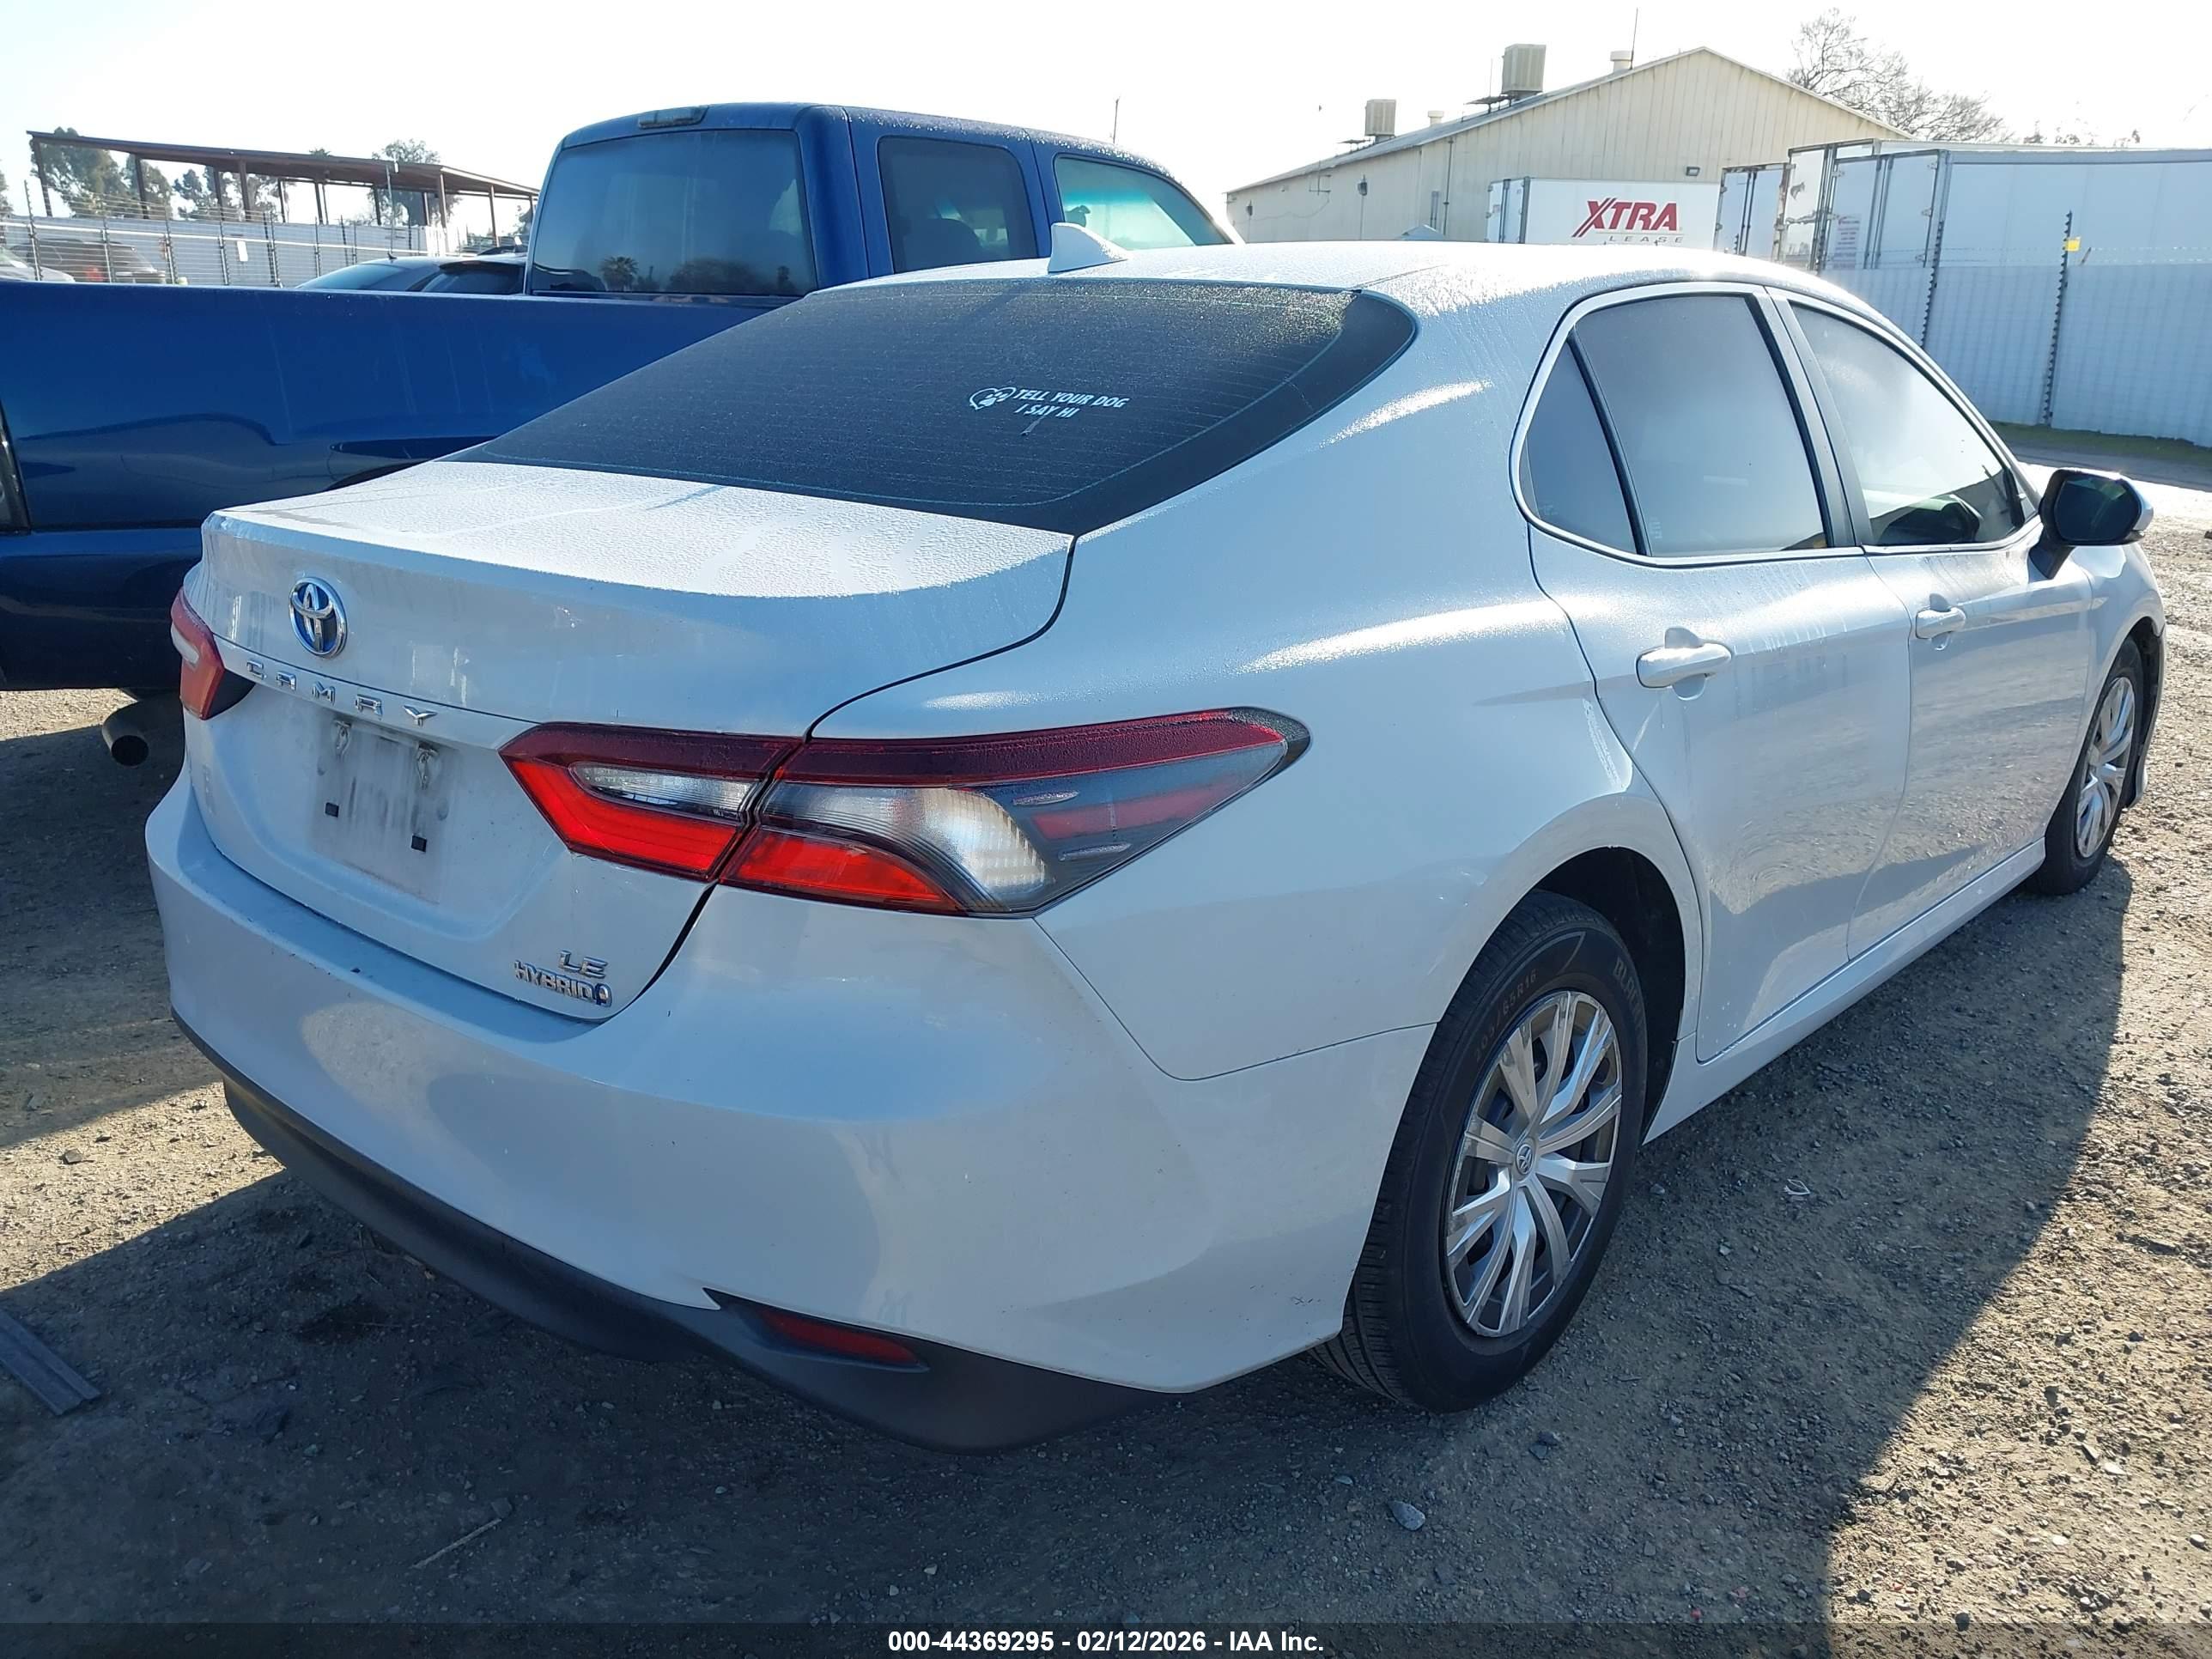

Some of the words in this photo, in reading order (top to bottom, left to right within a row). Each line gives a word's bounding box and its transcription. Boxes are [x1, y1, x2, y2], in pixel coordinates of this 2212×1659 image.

[1571, 198, 1677, 237] XTRA
[1609, 235, 1684, 244] LEASE
[1012, 389, 1049, 401] TELL
[1050, 392, 1093, 405] YOUR
[1093, 396, 1130, 408] DOG
[1014, 404, 1026, 413] I
[1025, 404, 1056, 416] SAY
[1055, 407, 1080, 418] HI
[246, 659, 438, 727] CAMRY
[558, 949, 609, 980] LE
[514, 959, 595, 1003] HYBRID
